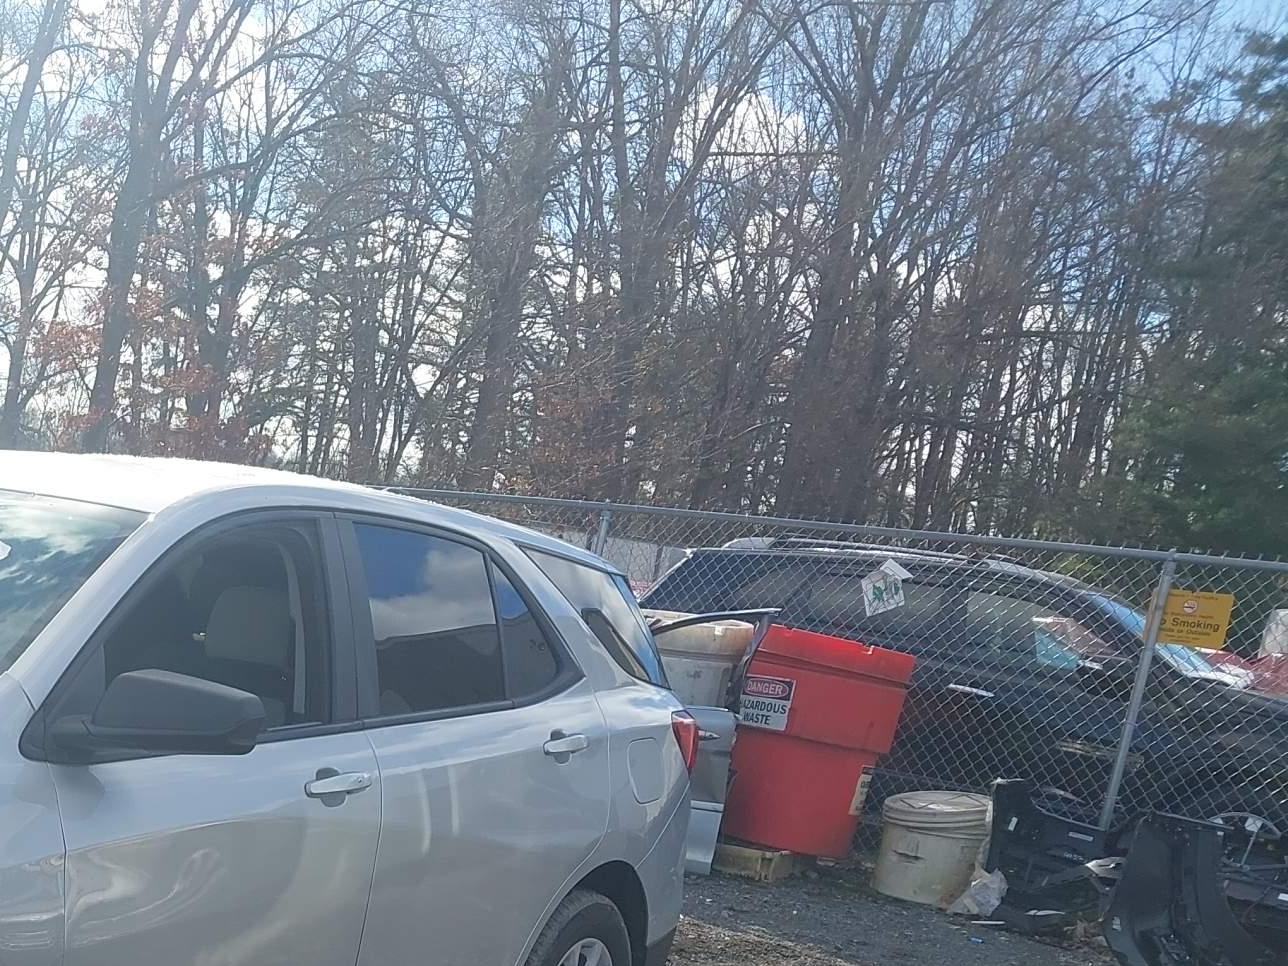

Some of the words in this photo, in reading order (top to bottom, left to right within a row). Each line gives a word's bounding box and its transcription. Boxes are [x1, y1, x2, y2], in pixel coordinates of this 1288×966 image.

[1171, 617, 1220, 632] Smoking
[747, 681, 783, 695] DANGER
[743, 711, 771, 725] WASTE
